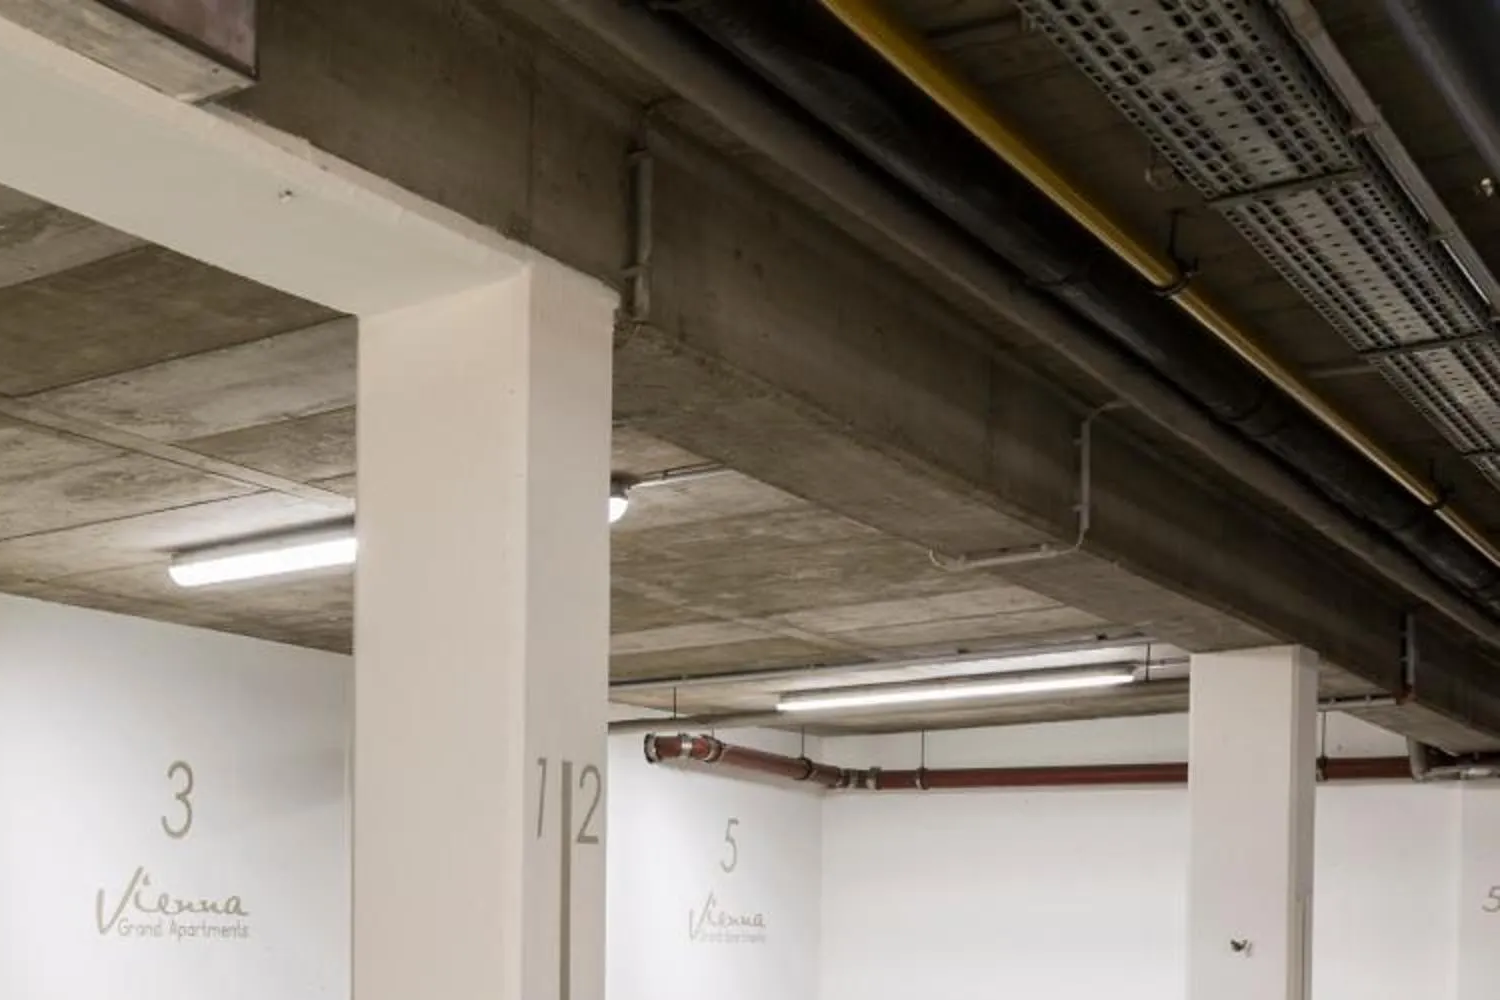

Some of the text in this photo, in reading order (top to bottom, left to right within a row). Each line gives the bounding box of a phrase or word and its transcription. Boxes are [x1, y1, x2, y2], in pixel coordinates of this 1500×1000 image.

[161, 760, 193, 838] 3
[536, 757, 602, 844] 1 2
[720, 818, 739, 873] 5
[96, 866, 249, 935] Vienna
[117, 918, 250, 941] Grand Apartments
[1481, 885, 1500, 913] 5
